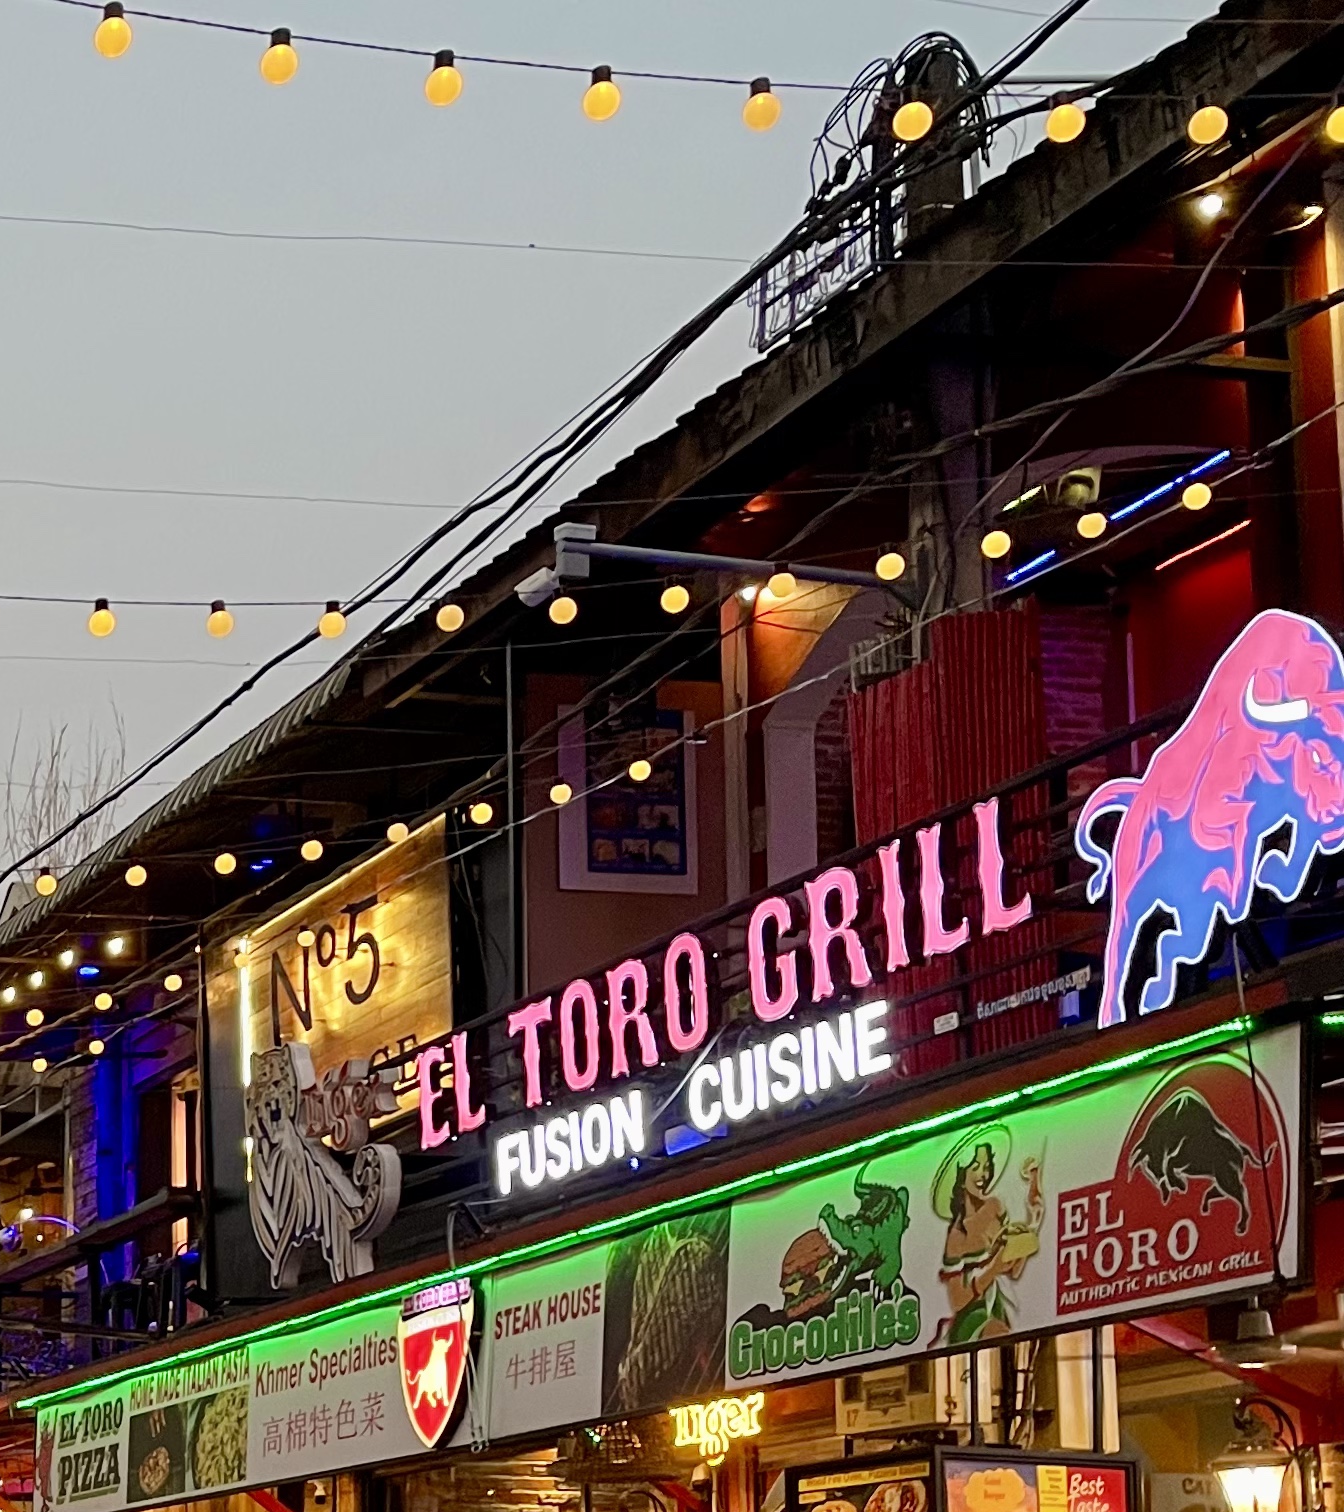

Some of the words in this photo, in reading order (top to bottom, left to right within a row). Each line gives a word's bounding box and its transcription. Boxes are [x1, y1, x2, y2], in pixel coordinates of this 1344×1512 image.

[416, 1031, 487, 1150] EL
[508, 932, 710, 1107] TORO
[747, 797, 1033, 1022] GRILL
[496, 1090, 646, 1195] FUSION
[687, 998, 893, 1132] CUISINE
[1060, 1190, 1126, 1241] EL
[1060, 1217, 1200, 1287] TORO
[1060, 1277, 1141, 1306] AUTHENTIC
[1145, 1258, 1214, 1290] MEXICAN
[1218, 1250, 1264, 1274] GRILL
[495, 1304, 544, 1339] STEAK
[547, 1281, 602, 1328] HOUSE
[730, 1281, 921, 1380] Crocodile's
[130, 1375, 154, 1411] HOME
[156, 1367, 180, 1405] MADE
[182, 1354, 219, 1398] ITALIAN
[221, 1345, 250, 1386] PASTA
[255, 1354, 304, 1398] Khmer
[309, 1329, 398, 1383] Specialties
[505, 1340, 577, 1392] 牛排屋
[262, 1391, 386, 1457] 高棉特色菜
[58, 1443, 122, 1503] PIZZA
[1070, 1473, 1106, 1497] Best
